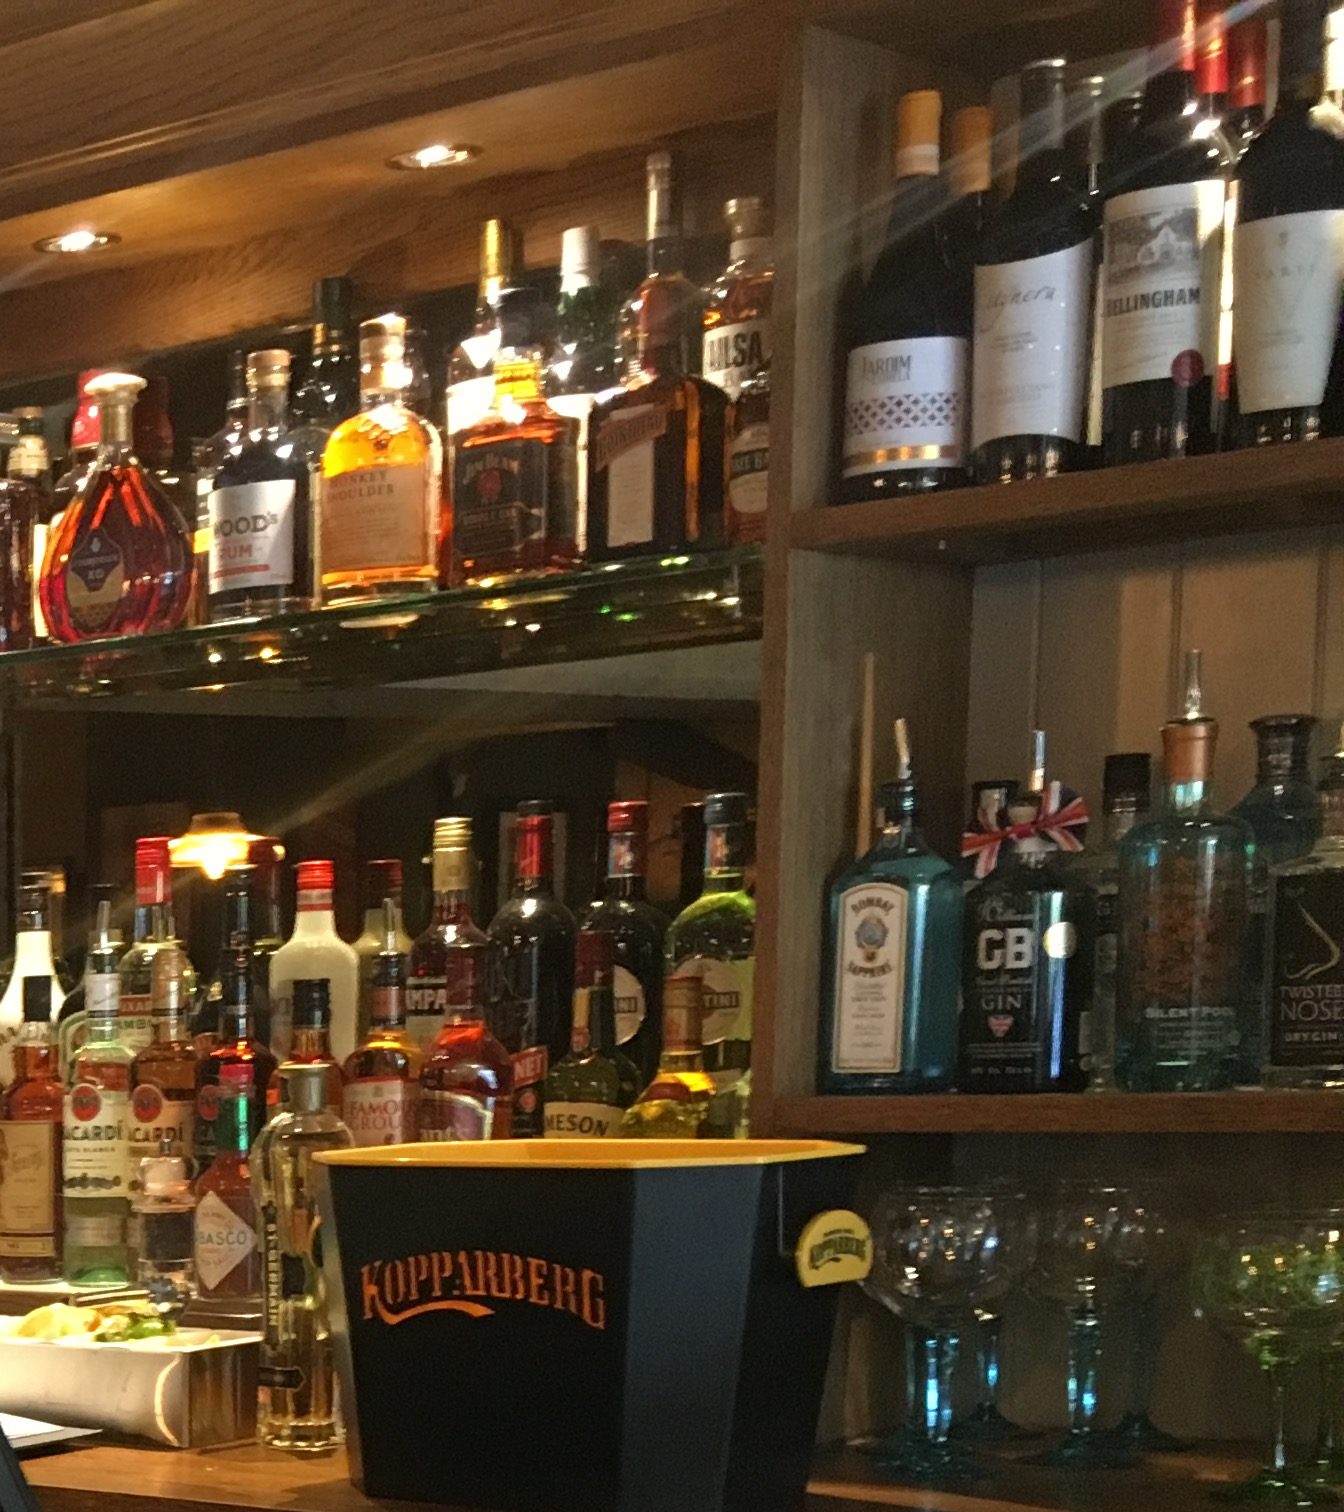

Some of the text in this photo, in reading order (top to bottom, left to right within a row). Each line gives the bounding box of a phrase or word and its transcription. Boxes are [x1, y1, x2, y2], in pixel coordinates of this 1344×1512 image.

[977, 927, 1033, 971] GB
[981, 994, 1022, 1011] GIN
[1144, 1006, 1197, 1019] SILENT
[361, 1247, 607, 1331] KOPPARBERG
